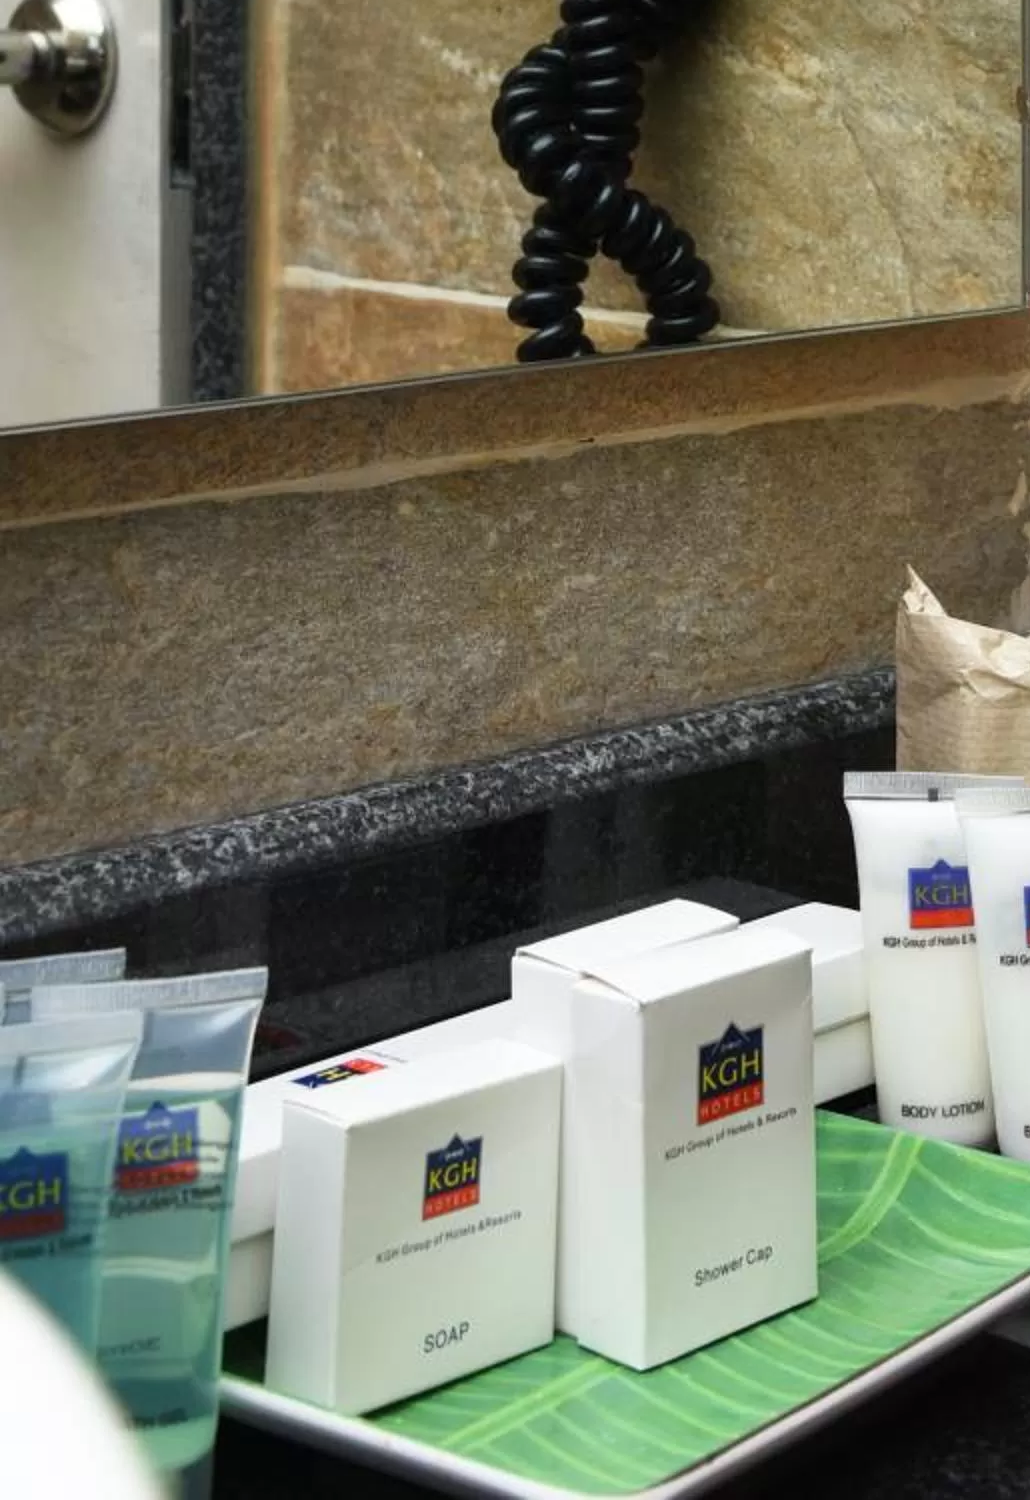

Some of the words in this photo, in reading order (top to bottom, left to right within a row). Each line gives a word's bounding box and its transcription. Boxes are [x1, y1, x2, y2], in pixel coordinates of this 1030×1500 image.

[914, 883, 970, 906] KGH
[902, 936, 926, 948] Group
[702, 1048, 760, 1093] KGH
[700, 1085, 761, 1118] HOTELS
[901, 1104, 936, 1118] BODY
[941, 1100, 985, 1118] LOTION
[121, 1130, 194, 1165] KGH
[665, 1144, 685, 1161] KGH
[686, 1136, 714, 1153] Group
[715, 1127, 725, 1143] of
[726, 1120, 755, 1137] Hotels
[765, 1106, 797, 1124] Resorts
[429, 1157, 477, 1192] KGH
[376, 1247, 400, 1263] KGH
[401, 1240, 431, 1256] Group
[433, 1232, 443, 1247] of
[445, 1223, 476, 1241] Hotels
[695, 1254, 744, 1288] Shower
[745, 1245, 773, 1271] Cap
[423, 1322, 469, 1353] SOAP
